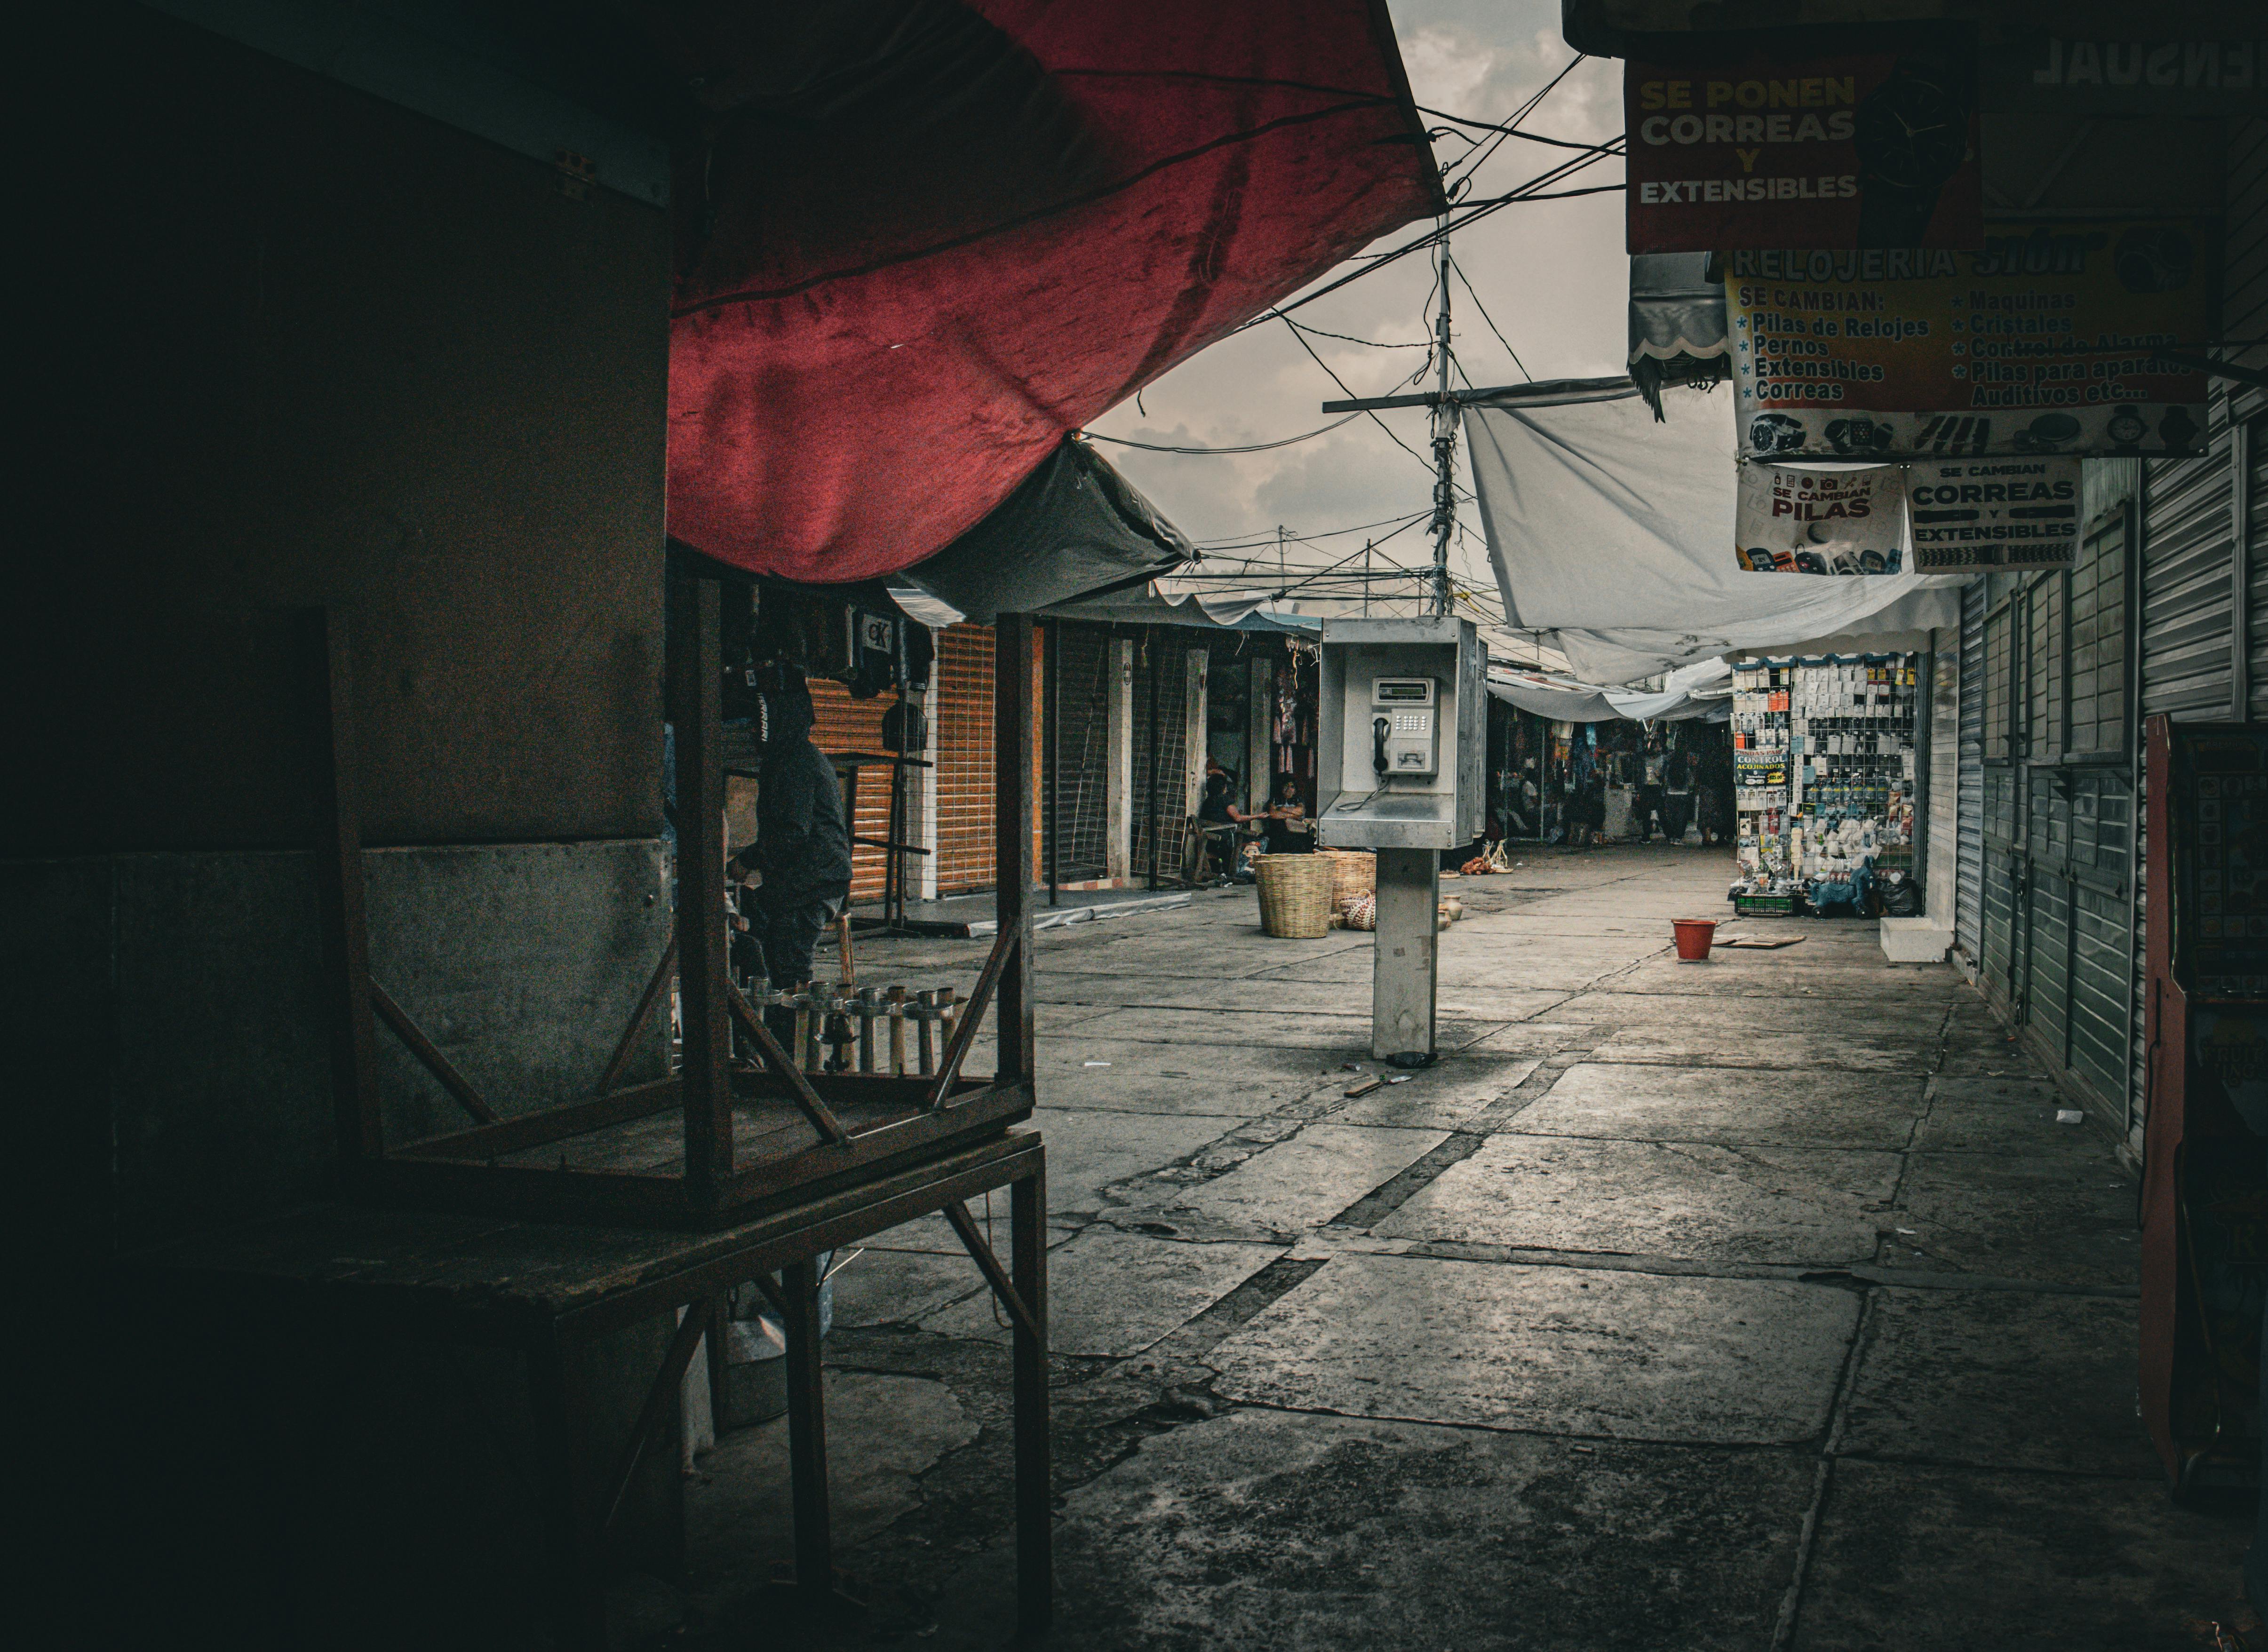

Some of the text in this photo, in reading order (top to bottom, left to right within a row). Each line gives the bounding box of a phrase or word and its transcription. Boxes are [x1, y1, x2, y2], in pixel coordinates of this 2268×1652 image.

[1640, 76, 1855, 110] SE PONEN
[1640, 111, 1855, 146] CORREAS
[1736, 148, 1761, 173] Y
[1640, 175, 1858, 204] EXTENSIBLES
[1733, 250, 1957, 282] RELOJERIA
[1739, 286, 1884, 311] SE CAMBIAN:
[1969, 290, 2076, 314] Maquinas
[1752, 312, 1929, 342] Pilas de Relojes
[1970, 314, 2072, 334] Cristales
[1754, 335, 1829, 356] Pernos
[1755, 357, 1884, 382] Extensibles
[1971, 361, 2027, 383] Pilas
[2034, 363, 2086, 387] para
[1756, 380, 1844, 401] Correas
[1971, 384, 2080, 406] Auditivos
[1940, 464, 2045, 478] SE CAMBIAN
[1773, 487, 1870, 501] SE CAMBIAN
[1912, 481, 2075, 505] CORREAS
[1772, 498, 1870, 521] PILAS
[1989, 510, 1999, 518] Y
[1915, 523, 2077, 541] EXTENSIBLES
